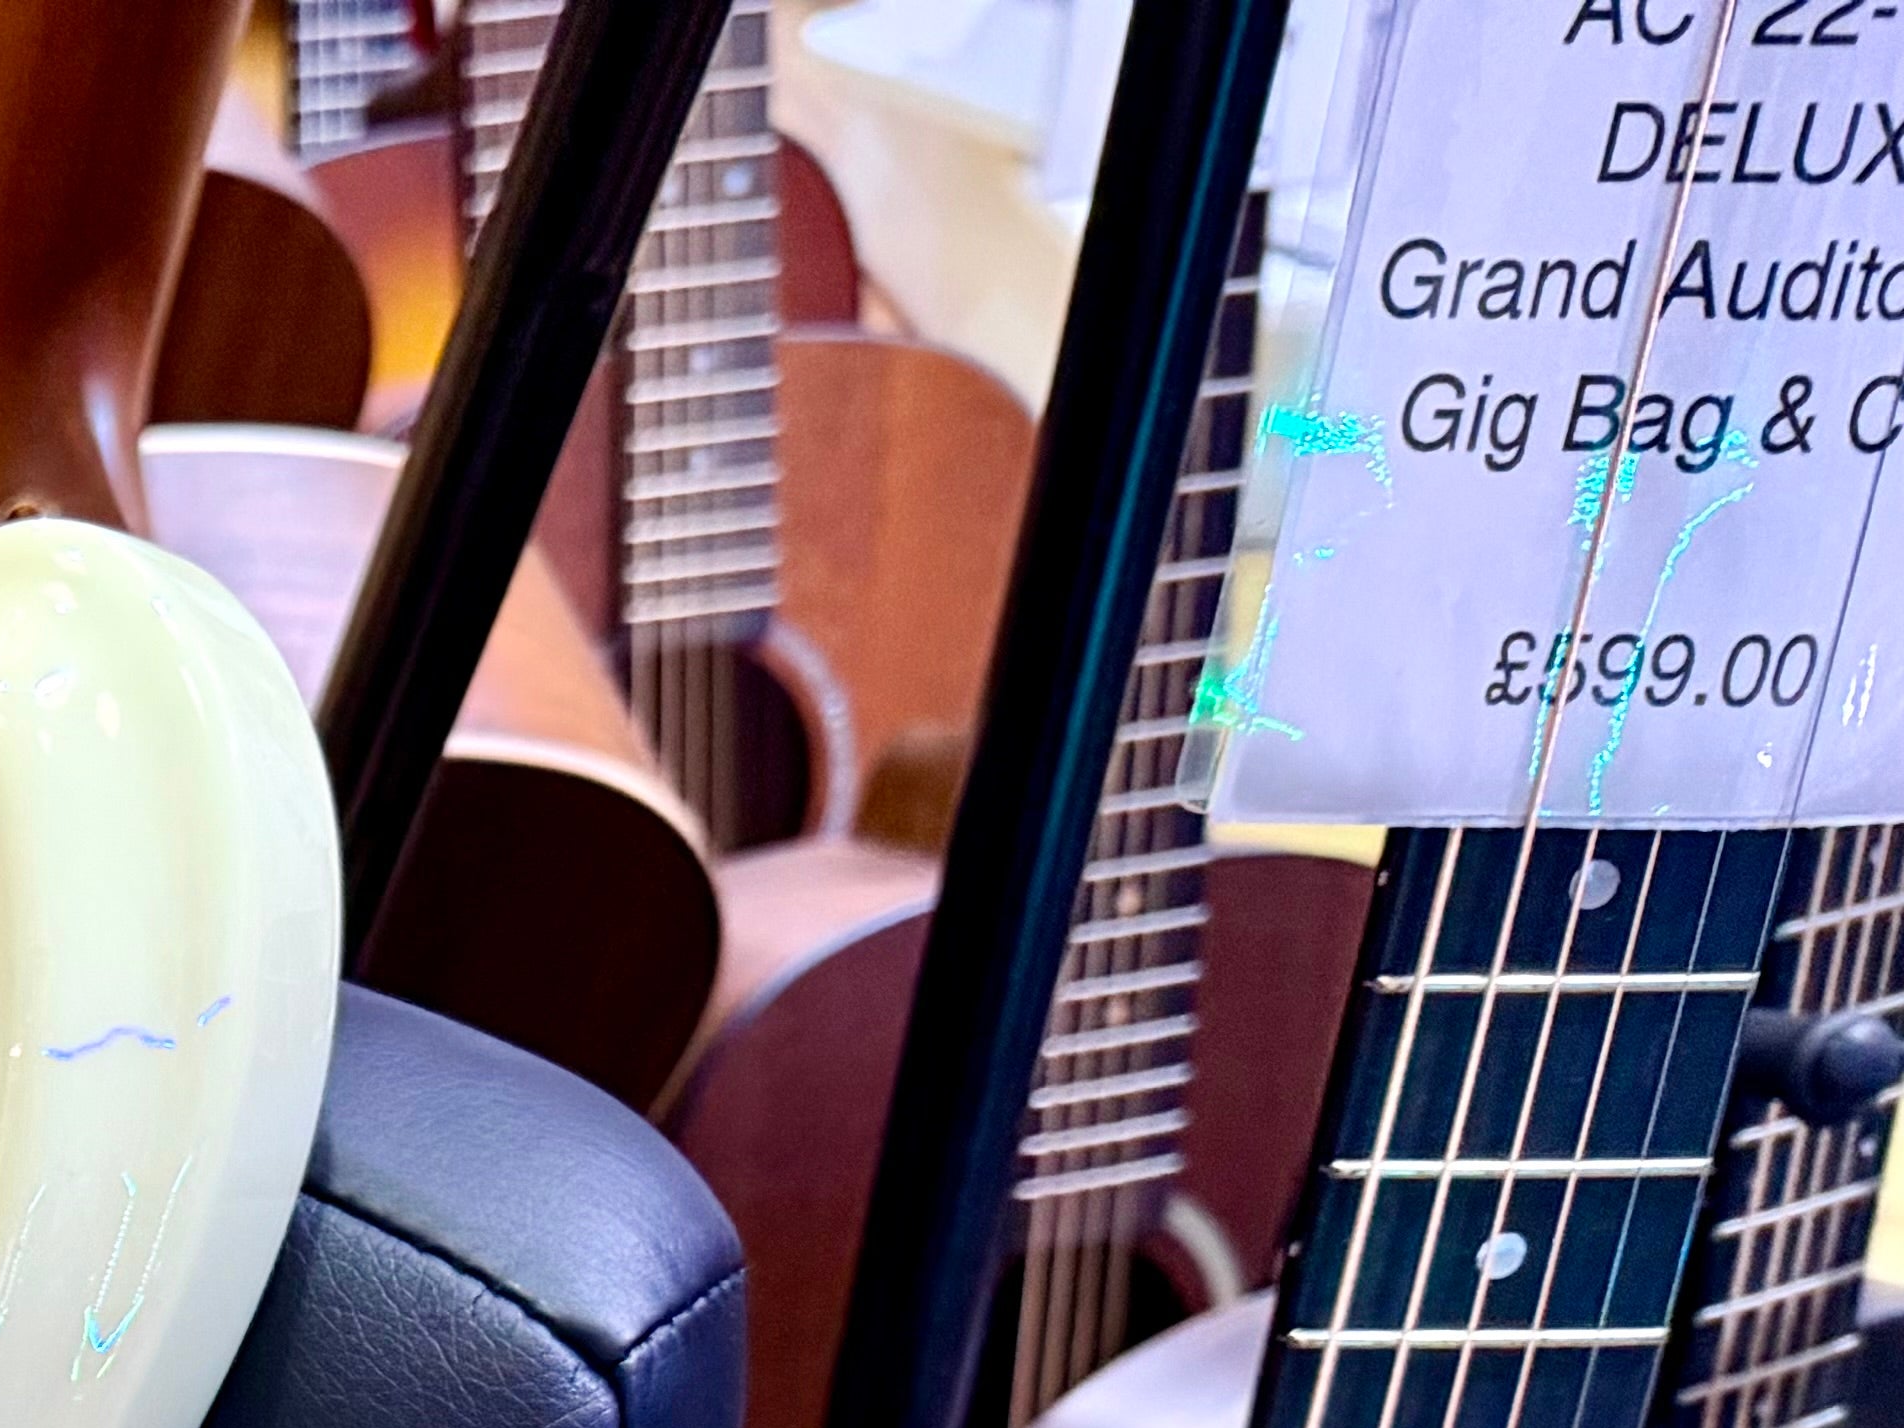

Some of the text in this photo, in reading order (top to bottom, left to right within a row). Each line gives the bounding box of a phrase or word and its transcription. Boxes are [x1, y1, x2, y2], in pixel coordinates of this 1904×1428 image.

[1563, 0, 1694, 45] AC
[1380, 237, 1637, 320] Grand
[1401, 372, 1540, 473] Gig
[1560, 373, 1735, 474] Bag
[1760, 374, 1817, 454] &
[1485, 630, 1819, 708] £599.00
